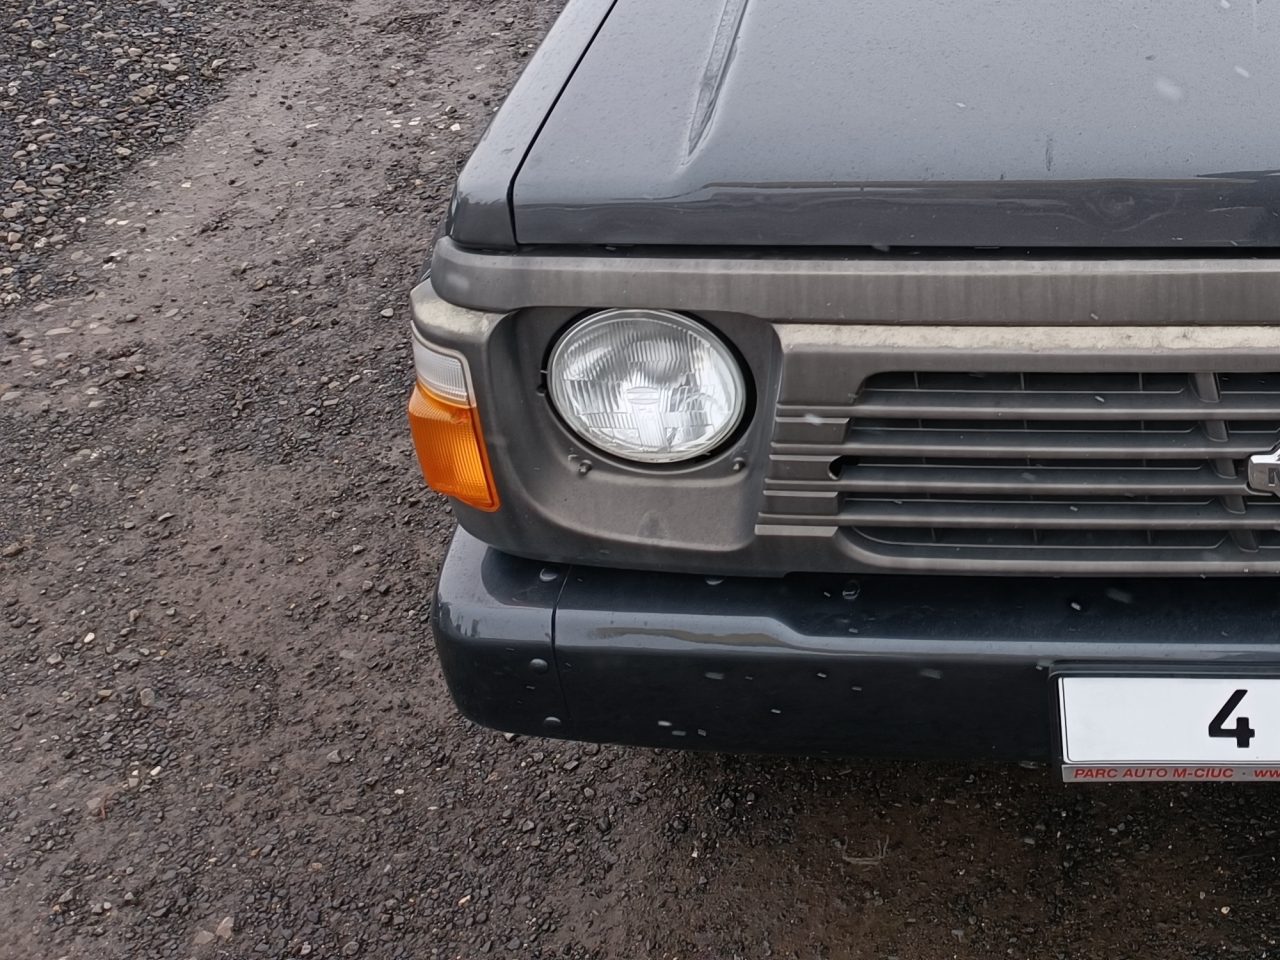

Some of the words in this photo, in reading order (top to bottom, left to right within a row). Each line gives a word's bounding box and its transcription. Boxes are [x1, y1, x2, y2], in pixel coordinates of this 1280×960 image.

[1074, 768, 1118, 779] PARC
[1122, 768, 1168, 778] AUTO
[1172, 768, 1234, 778] M-CIUC
